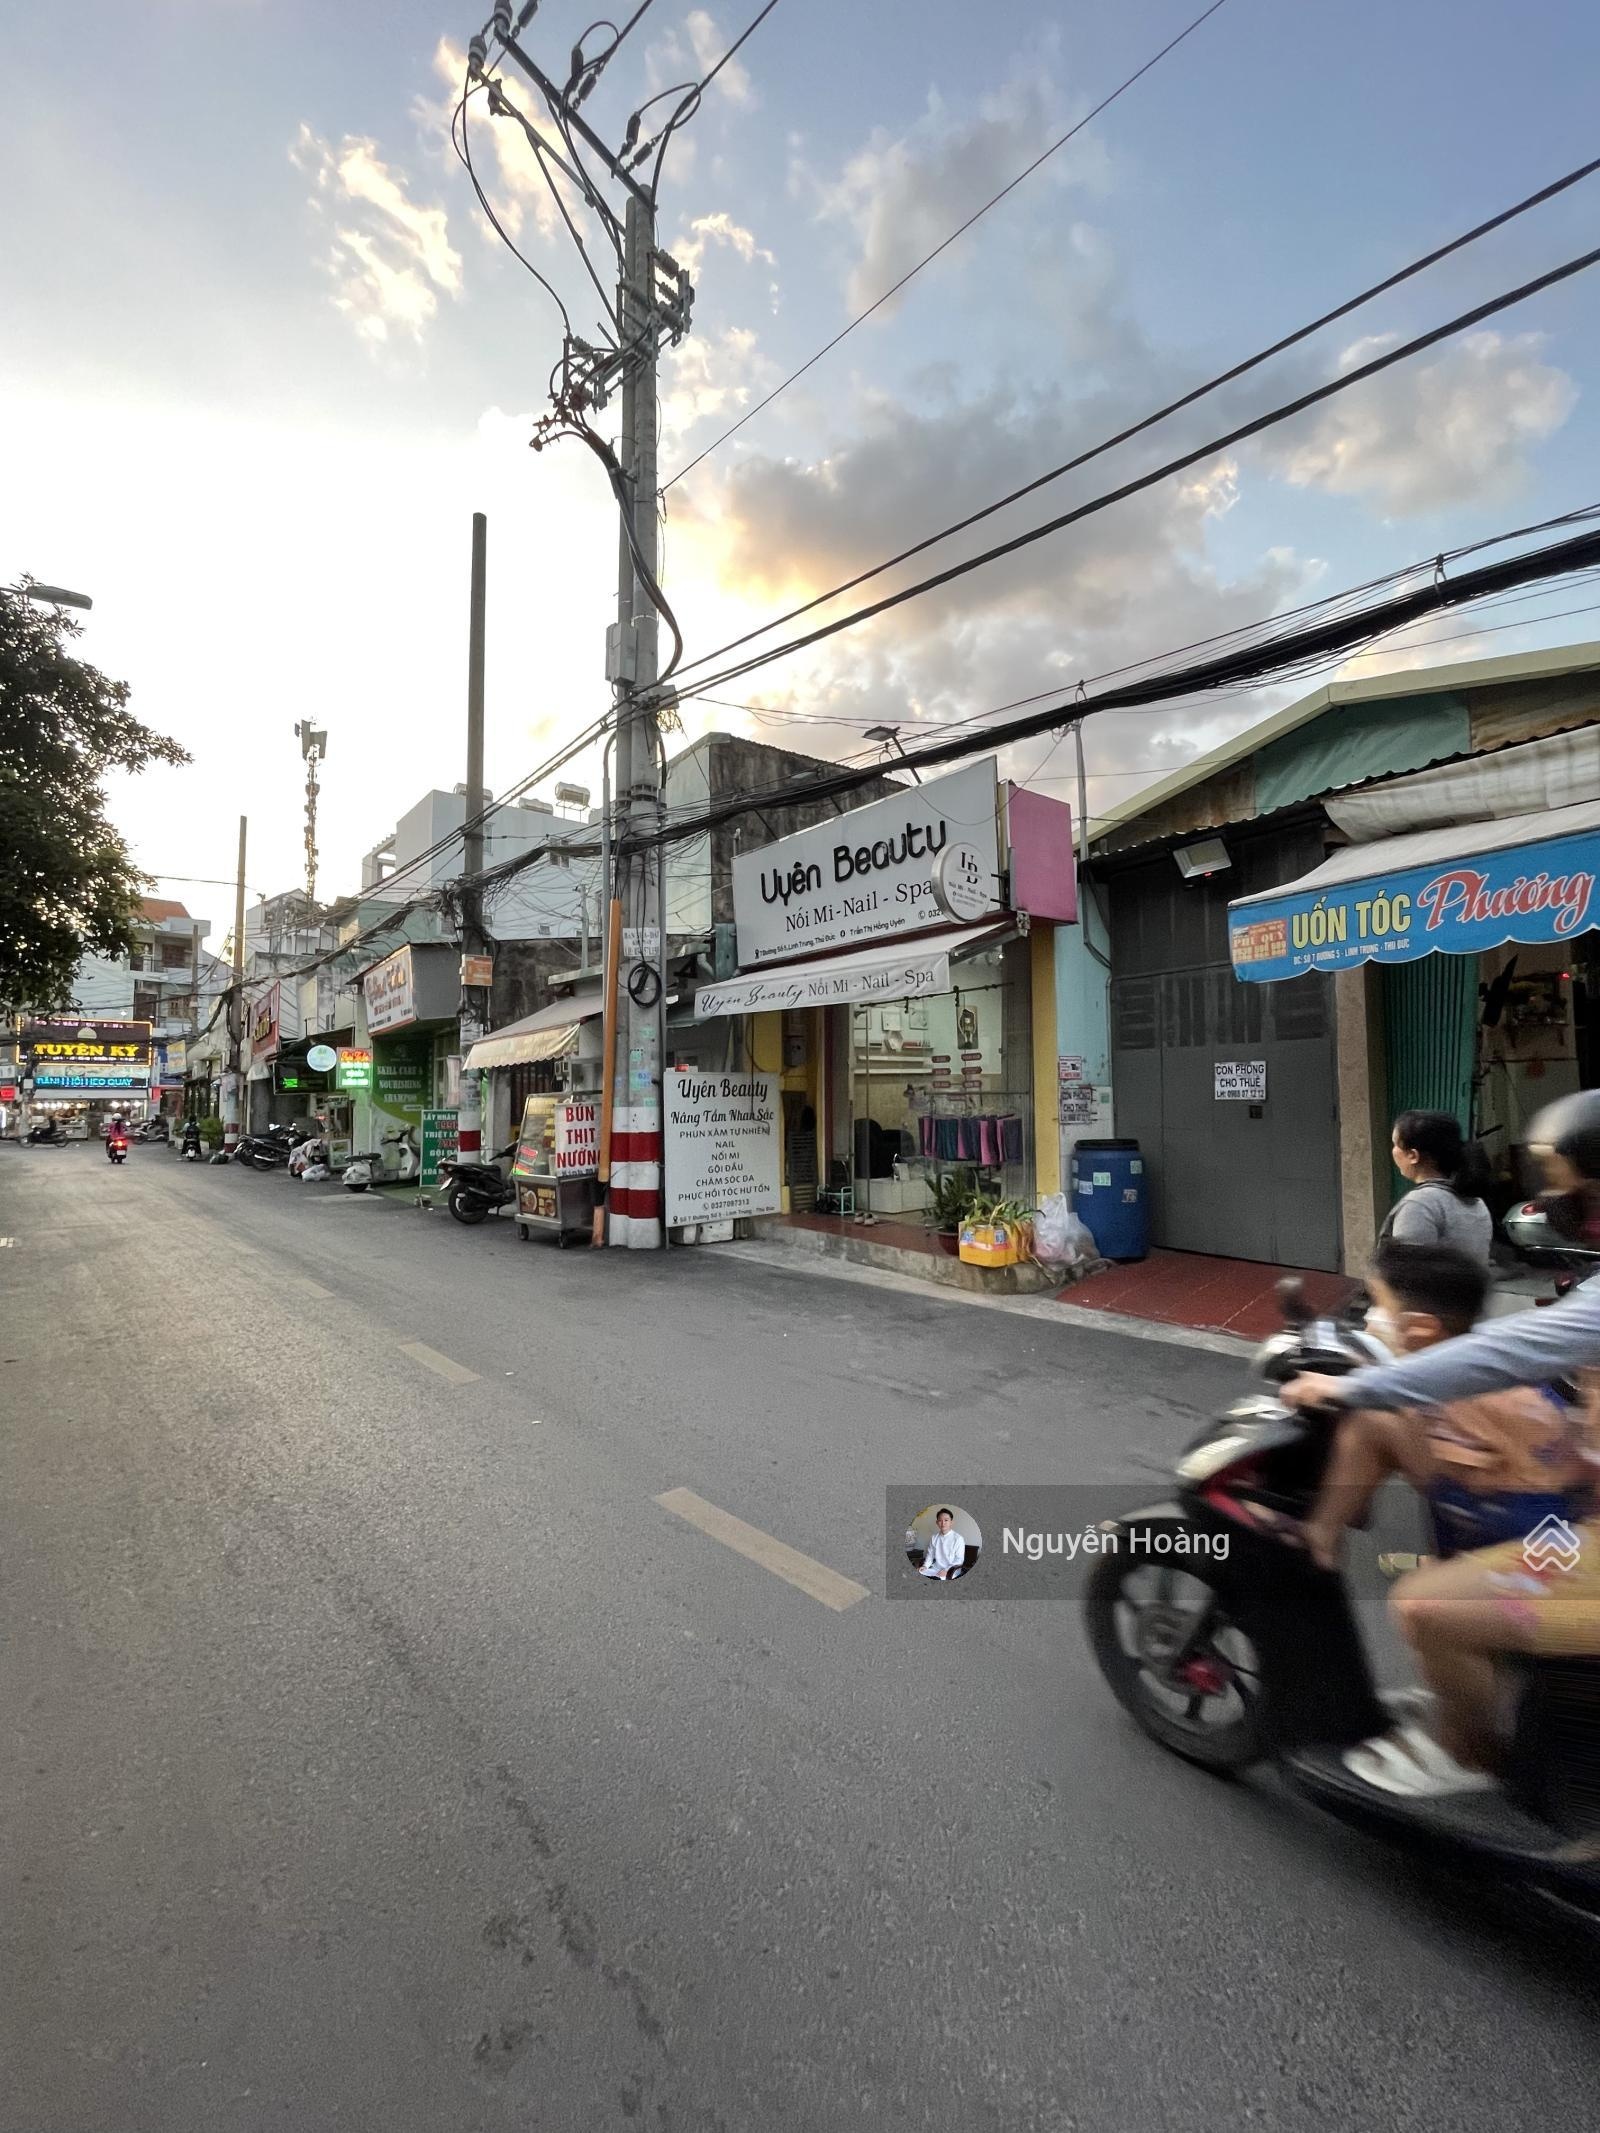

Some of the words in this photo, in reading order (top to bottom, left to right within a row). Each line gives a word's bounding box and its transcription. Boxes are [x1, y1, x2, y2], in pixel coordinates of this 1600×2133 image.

[760, 862, 822, 905] Uyên
[833, 820, 947, 882] Beauty
[786, 906, 810, 933] Nối
[895, 879, 933, 906] Spa
[1416, 870, 1596, 934] Phương
[1292, 896, 1347, 949] UỐN
[1355, 890, 1412, 937] TÓC
[808, 977, 829, 997] Nối
[832, 979, 849, 994] Mi
[862, 973, 890, 990] Nail
[904, 969, 934, 988] Spa
[678, 1079, 717, 1104] Uyên
[719, 1078, 768, 1103] Beauty
[1220, 1078, 1238, 1088] CHO
[565, 1104, 595, 1123] BÚN
[670, 1111, 701, 1128] Nâng
[729, 1108, 755, 1121] Nhan
[566, 1128, 596, 1147] THỊT
[680, 1129, 706, 1139] PHUN
[715, 1141, 735, 1149] NAIL
[729, 1152, 740, 1160] MI
[742, 1174, 755, 1183] DA
